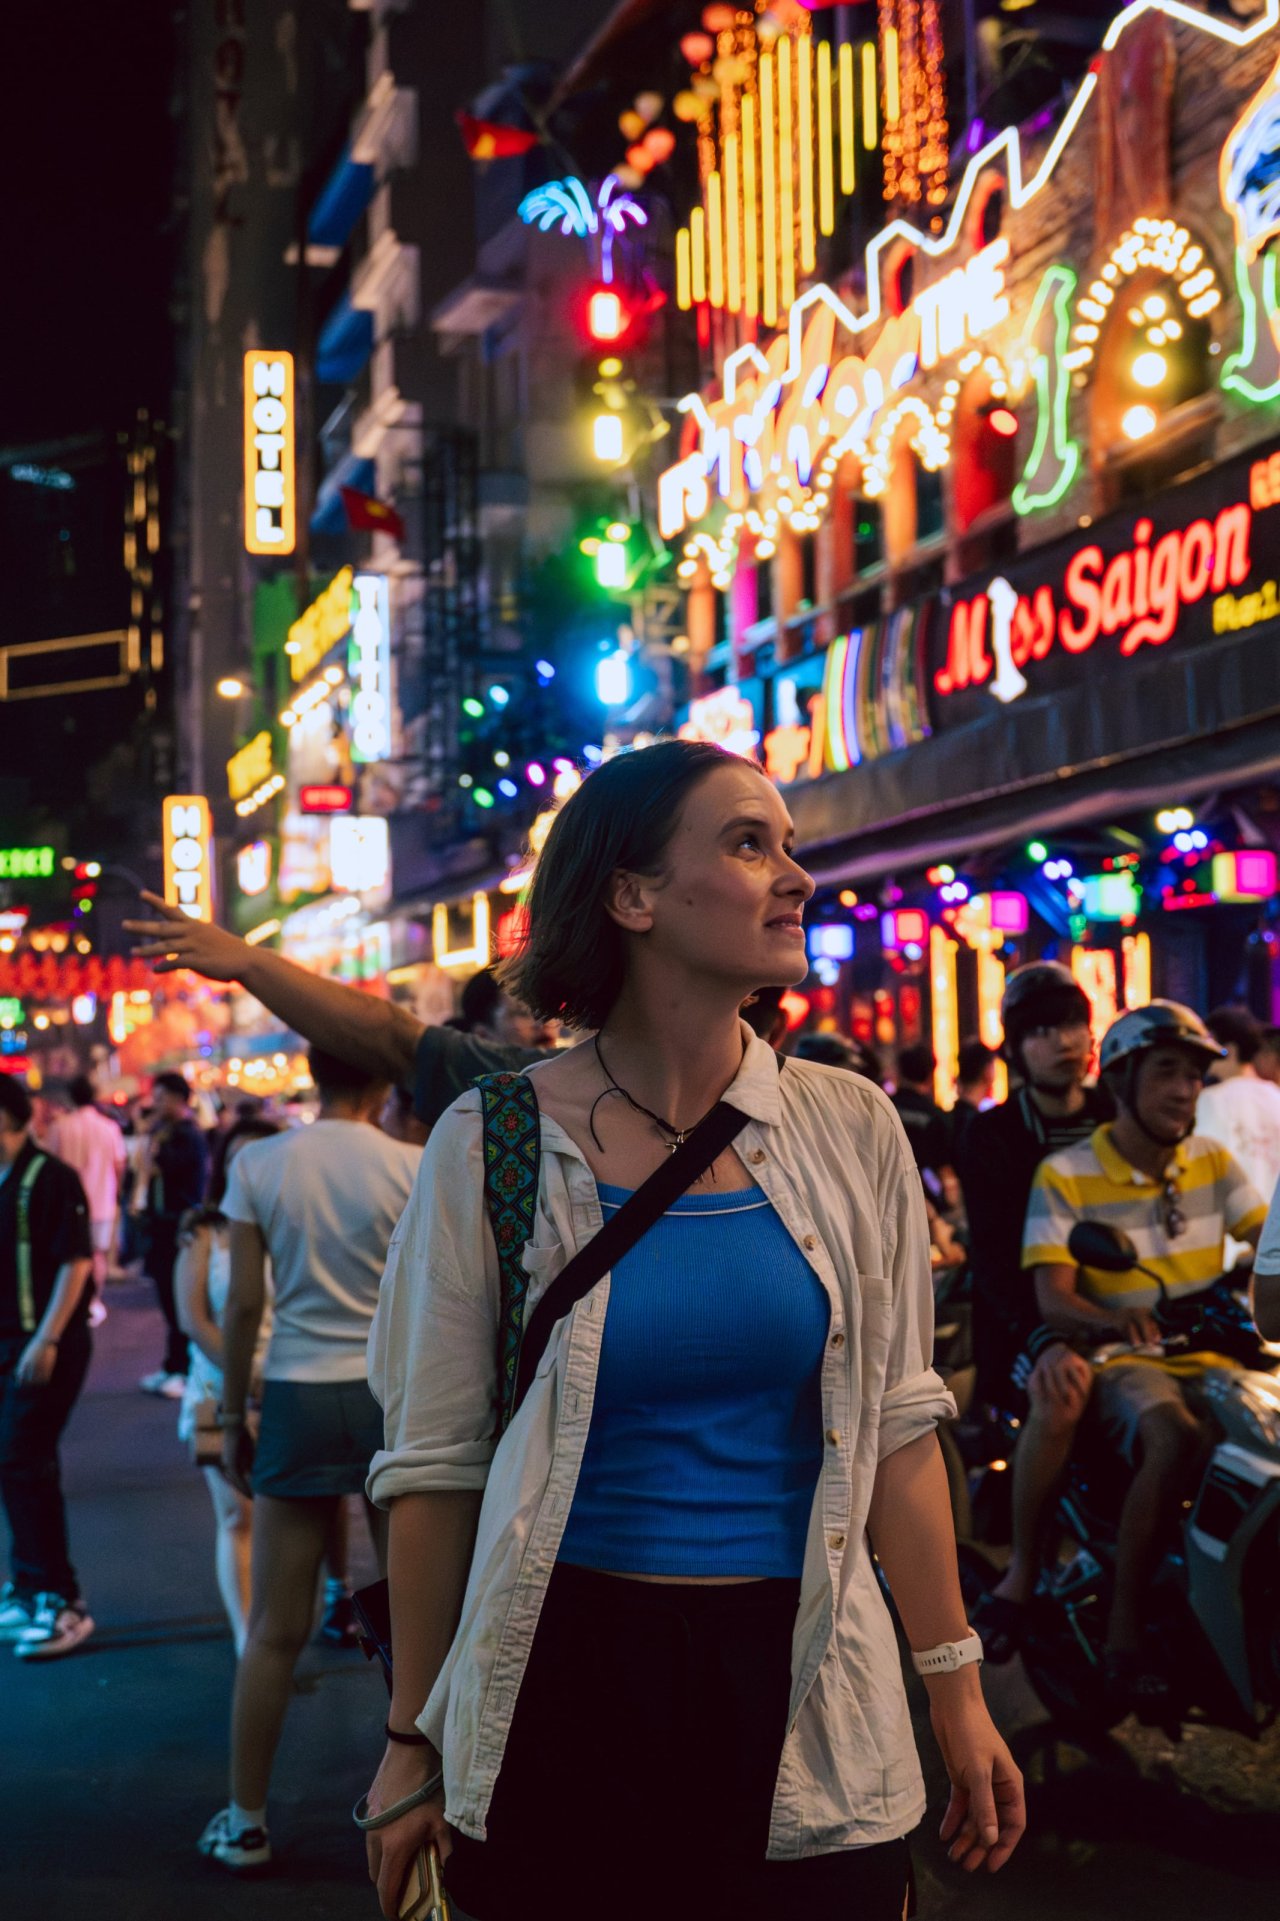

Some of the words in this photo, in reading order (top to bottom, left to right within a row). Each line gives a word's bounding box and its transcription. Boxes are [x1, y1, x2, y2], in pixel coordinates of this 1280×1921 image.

[252, 360, 287, 543] HOTEL
[1059, 502, 1250, 656] Saigon
[171, 805, 203, 919] HOT
